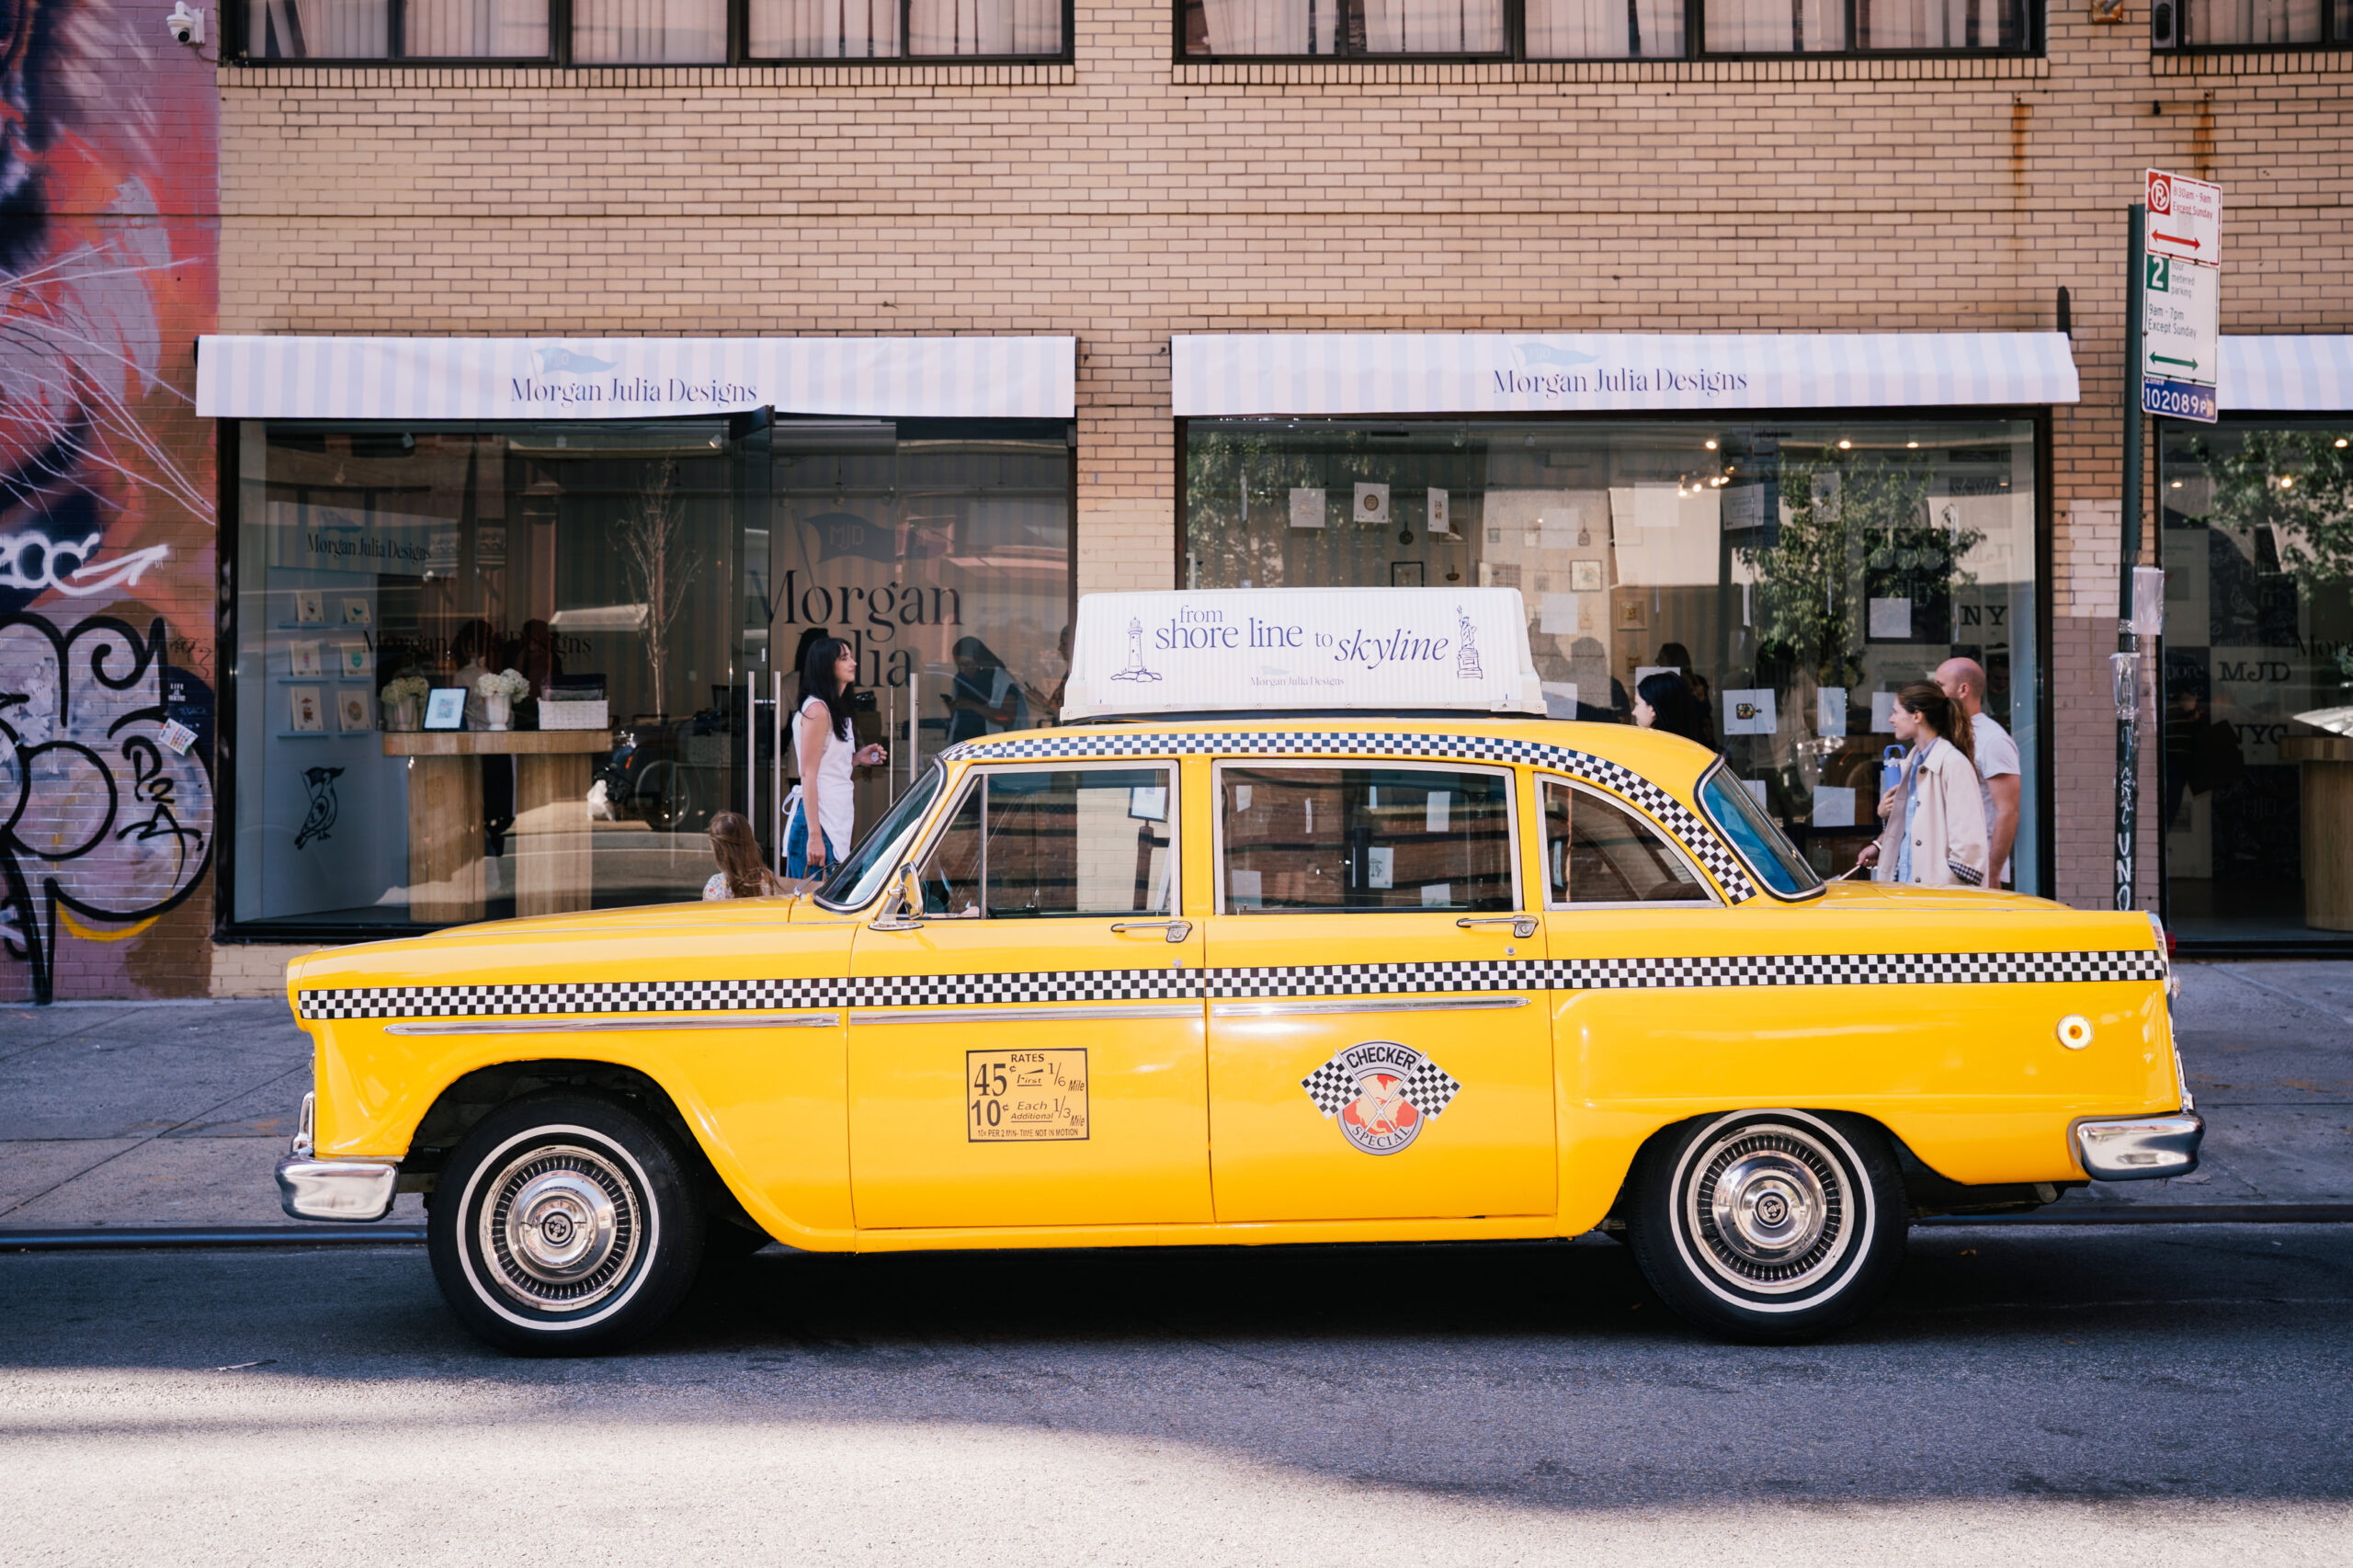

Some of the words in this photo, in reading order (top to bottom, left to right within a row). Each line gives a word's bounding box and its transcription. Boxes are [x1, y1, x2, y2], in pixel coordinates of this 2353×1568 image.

[2200, 191, 2211, 203] 9am
[2173, 200, 2191, 214] Except
[2193, 205, 2213, 221] Sunday
[2152, 256, 2164, 289] 2
[2172, 261, 2184, 271] hour
[2172, 274, 2195, 286] metered
[2171, 286, 2192, 300] parking
[2149, 302, 2163, 317] 9am
[2170, 307, 2184, 321] 7pm
[2148, 318, 2171, 335] Except
[2173, 323, 2197, 340] Sunday
[511, 377, 602, 409] Morgan
[608, 377, 661, 403] Julia
[668, 378, 757, 409] Designs
[1493, 369, 1586, 401] Morgan
[1594, 368, 1648, 392] Julia
[1655, 368, 1747, 398] Designs
[2146, 387, 2199, 415] 102089
[306, 533, 357, 560] Morgan
[358, 537, 386, 558] Julia
[387, 540, 431, 563] Designs
[745, 569, 963, 642] Morgan
[1180, 605, 1223, 623] from
[363, 630, 448, 656] Morgan
[1155, 618, 1239, 650] shore
[1248, 617, 1303, 648] line
[1315, 632, 1333, 648] to
[1334, 628, 1449, 670] skyline
[1251, 676, 1287, 687] Morgan
[1289, 676, 1308, 686] Julia
[1311, 676, 1345, 687] Designs
[2218, 661, 2291, 682] MJD
[1011, 1053, 1045, 1062] RATES
[1346, 1046, 1417, 1070] CHECKER
[1048, 1062, 1066, 1087] 1/6
[1068, 1079, 1086, 1092] Mile
[1011, 1112, 1054, 1120] Additional
[1017, 1101, 1048, 1110] Each
[1052, 1096, 1071, 1119] 1/3
[1070, 1115, 1086, 1127] Mile
[1020, 1129, 1033, 1137] TIME
[1035, 1129, 1047, 1137] NOT
[1048, 1129, 1055, 1137] IN
[1055, 1128, 1078, 1137] MOTION
[1351, 1125, 1410, 1148] SPECIAL
